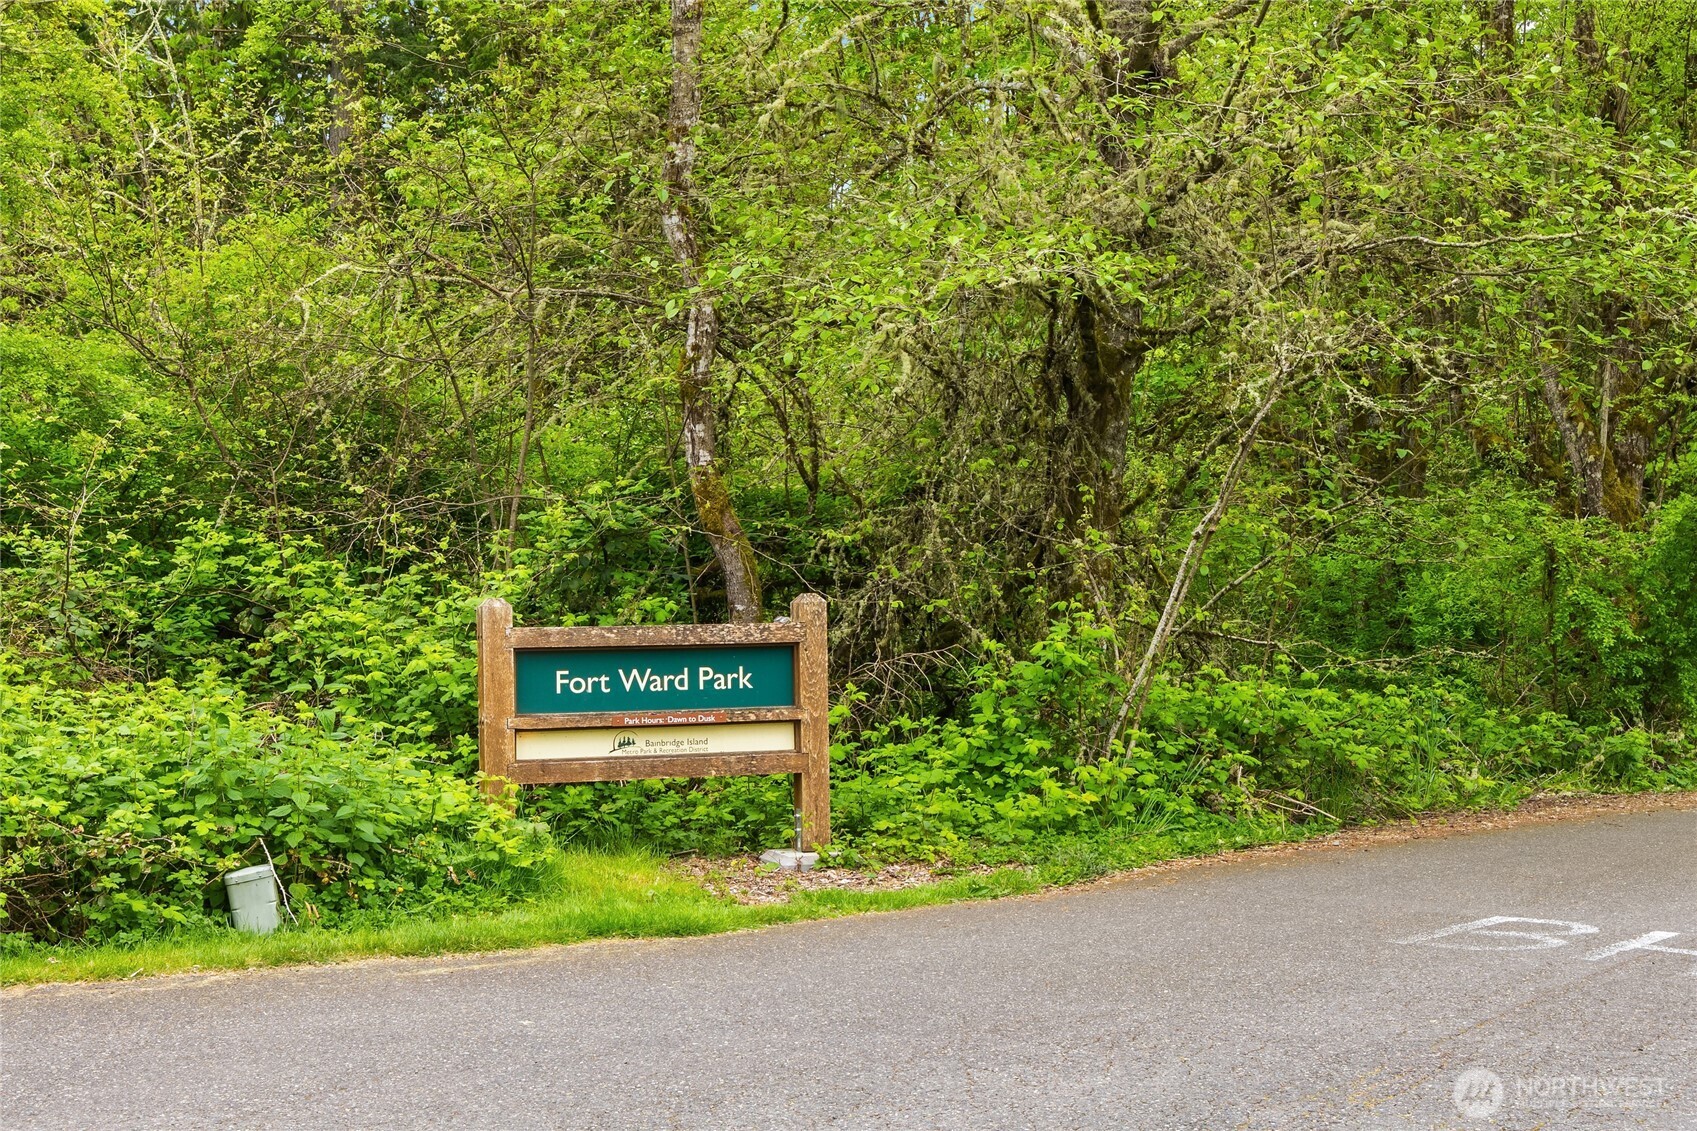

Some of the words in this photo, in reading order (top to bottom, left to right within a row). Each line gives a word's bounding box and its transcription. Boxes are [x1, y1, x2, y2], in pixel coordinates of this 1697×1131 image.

[555, 670, 611, 694] Fort
[618, 667, 689, 692] Ward
[699, 665, 753, 690] Park
[624, 717, 640, 725] Park
[641, 716, 665, 725] Hours:
[667, 715, 687, 723] Dawn
[689, 715, 697, 723] to
[698, 714, 716, 722] Dusk
[645, 738, 685, 748] Bainbridge
[687, 737, 709, 746] Island
[659, 746, 688, 754] Recreation
[689, 745, 709, 753] District
